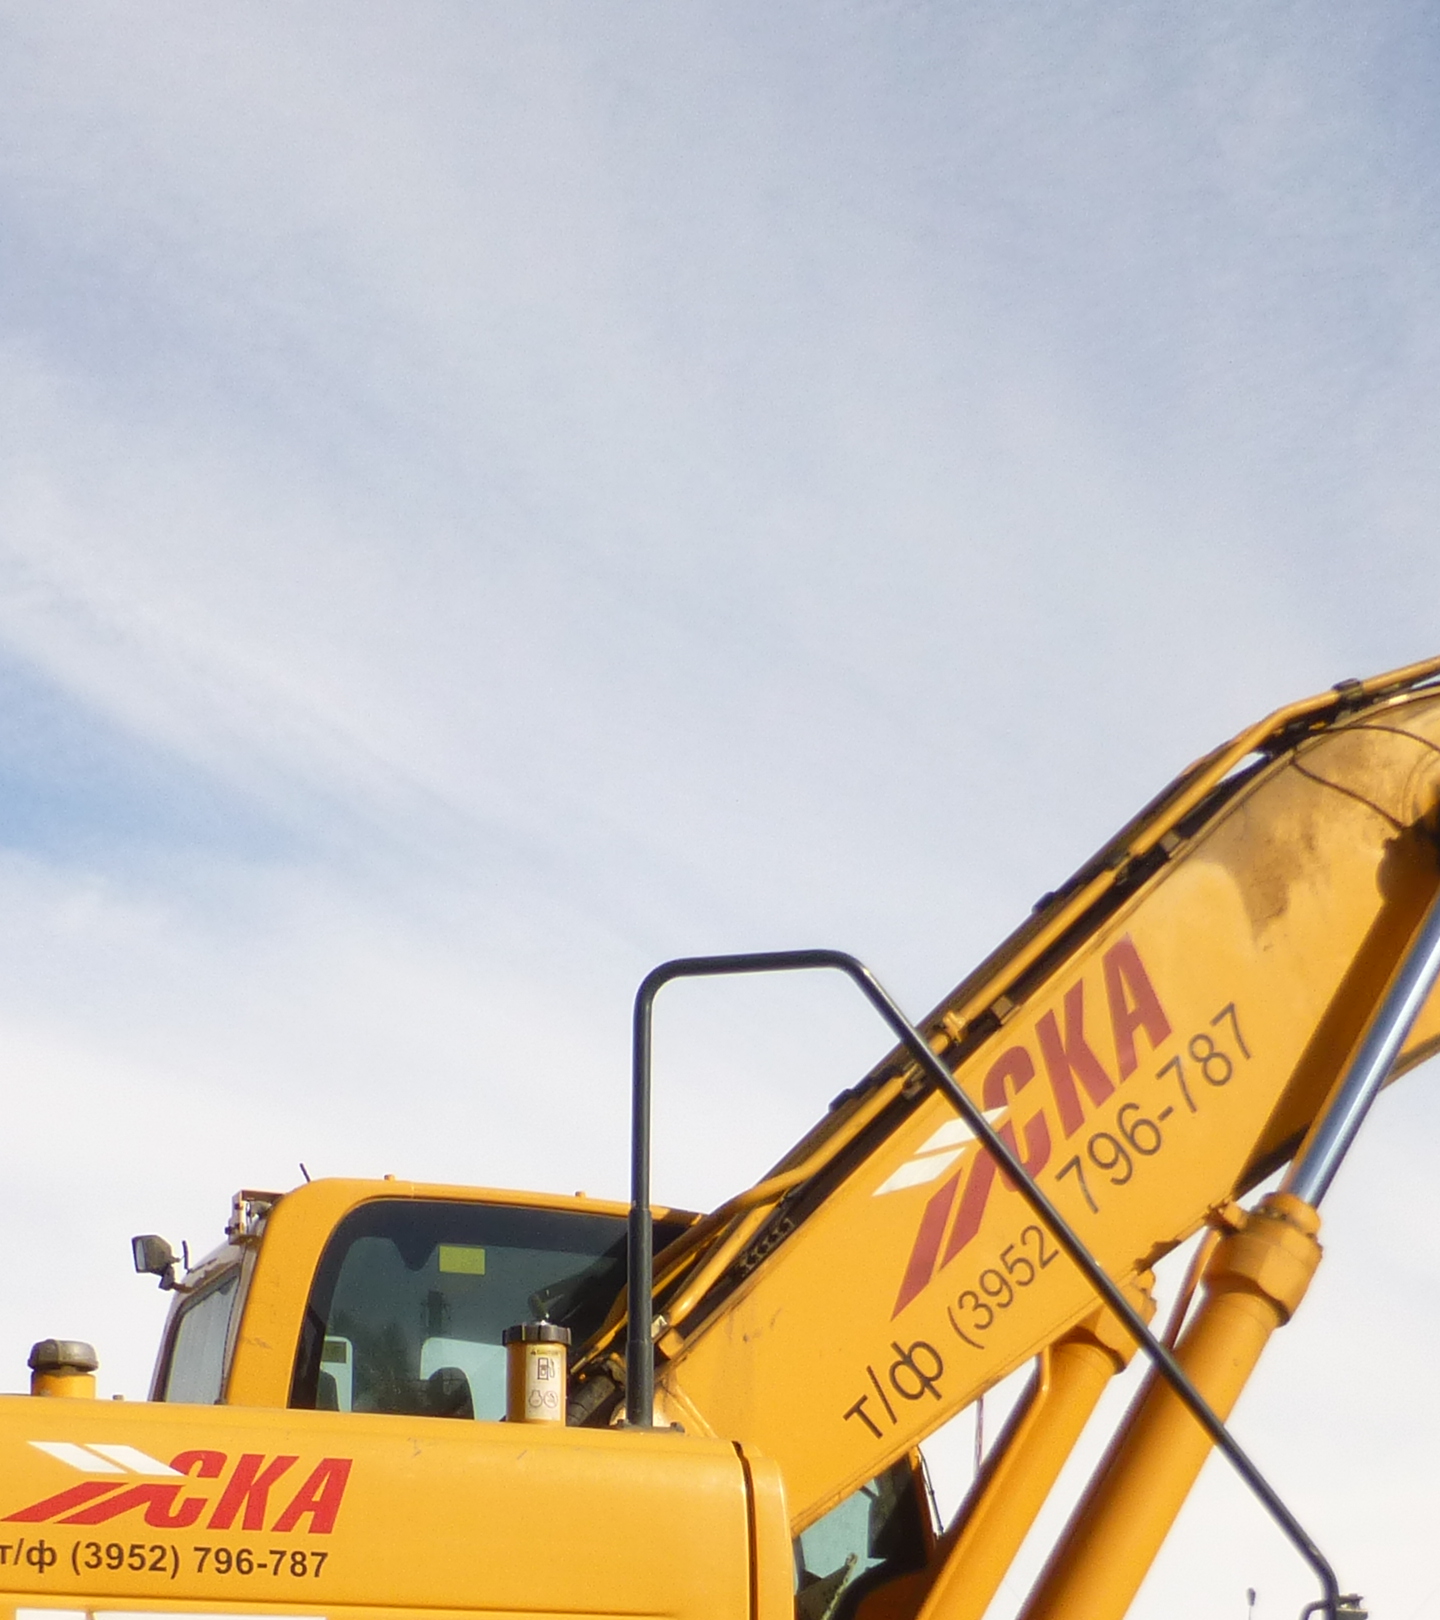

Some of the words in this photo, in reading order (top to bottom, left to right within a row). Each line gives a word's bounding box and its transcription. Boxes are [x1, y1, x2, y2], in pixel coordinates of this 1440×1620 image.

[843, 1340, 944, 1440] т/ф
[947, 1224, 1060, 1350] (3952
[1055, 1002, 1251, 1214] 796-787
[143, 1449, 353, 1534] СКА
[70, 1540, 181, 1579] (3952)
[193, 1545, 328, 1578] 796-787
